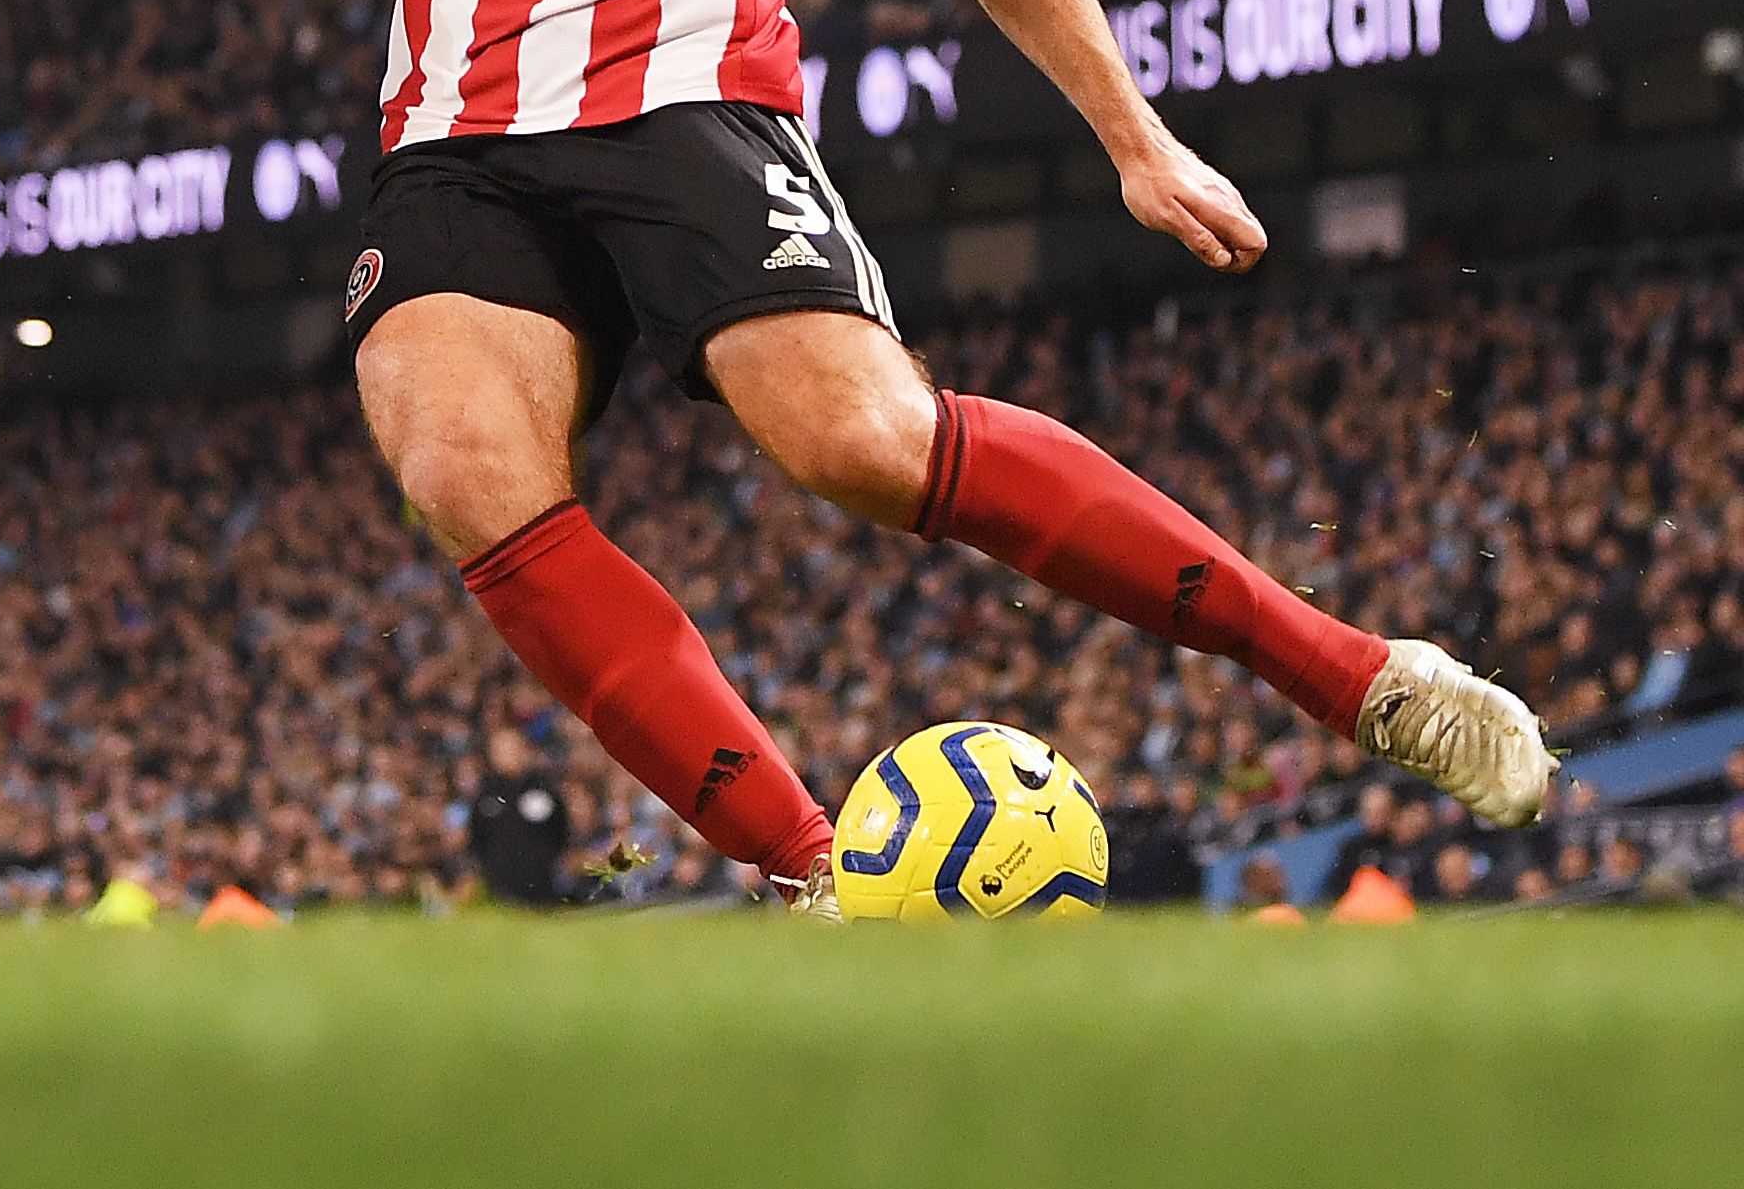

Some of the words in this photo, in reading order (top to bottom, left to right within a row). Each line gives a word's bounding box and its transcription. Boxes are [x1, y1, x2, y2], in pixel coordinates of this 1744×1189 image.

[136, 146, 231, 239] CITY
[764, 163, 831, 236] 5
[762, 256, 831, 270] adidas
[995, 840, 1024, 873] Premier
[1000, 846, 1032, 880] League
